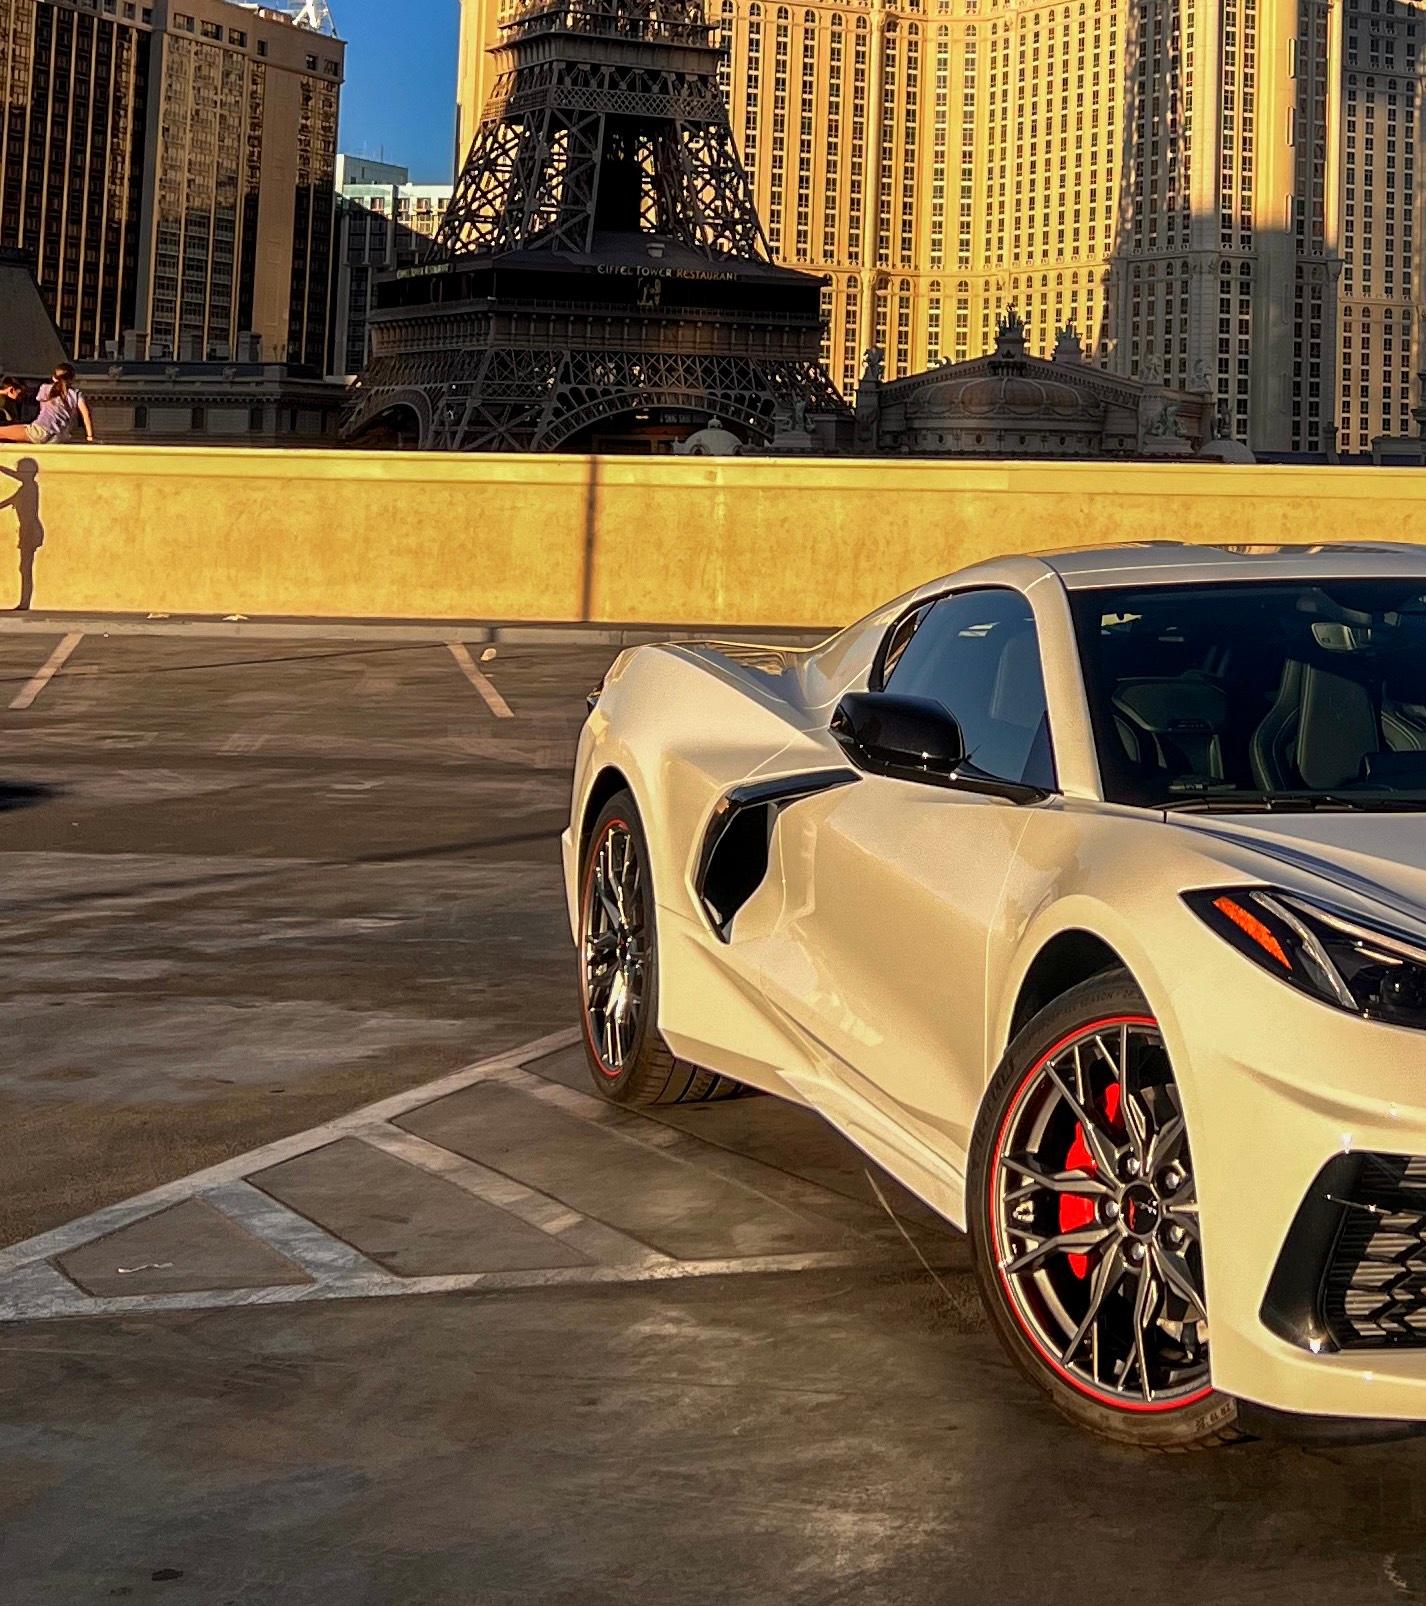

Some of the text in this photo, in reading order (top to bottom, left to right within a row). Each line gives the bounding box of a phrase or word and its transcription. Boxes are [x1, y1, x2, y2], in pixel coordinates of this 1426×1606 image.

[597, 264, 738, 281] EIFFEL TOWER RESTAURANT
